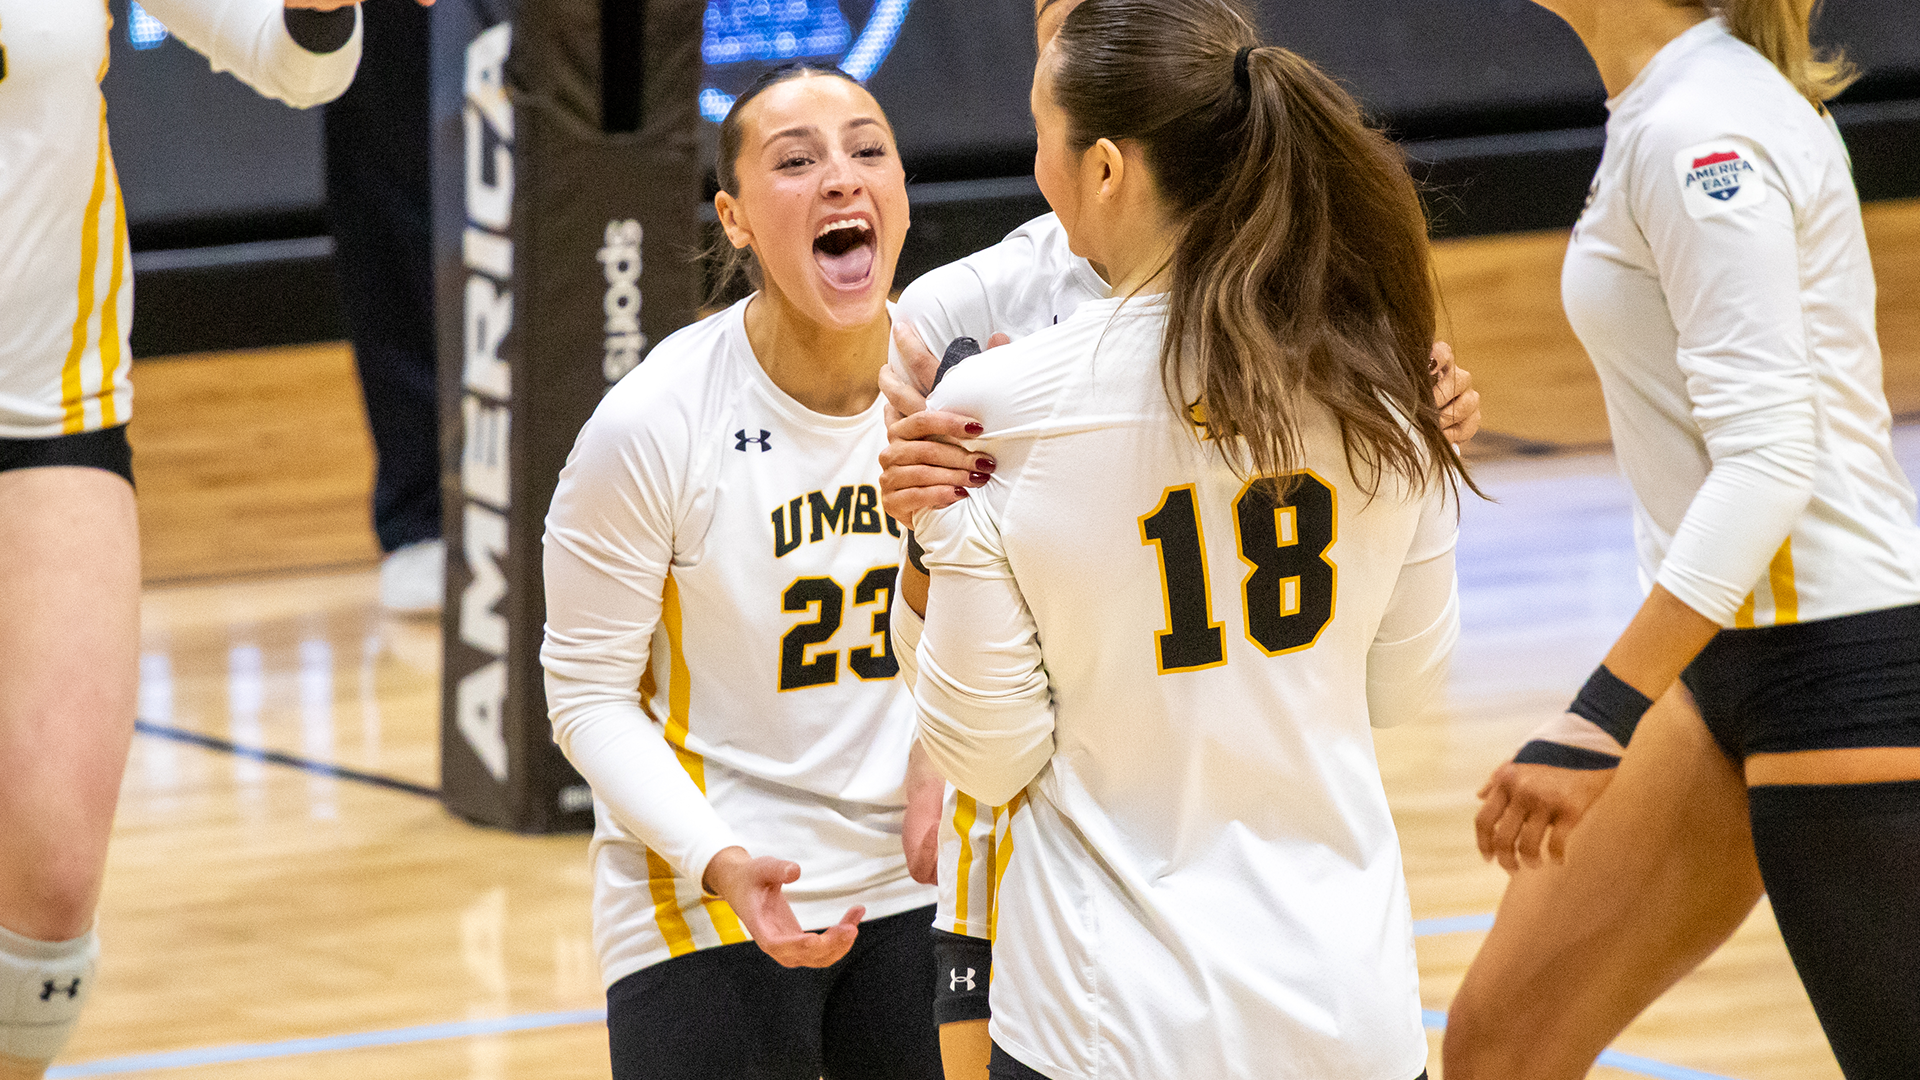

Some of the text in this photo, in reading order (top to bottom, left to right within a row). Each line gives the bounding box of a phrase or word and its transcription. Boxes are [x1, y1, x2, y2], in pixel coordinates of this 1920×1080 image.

[1685, 160, 1754, 188] AMERICA
[1702, 173, 1739, 191] EAST
[596, 218, 647, 382] sports
[457, 21, 514, 782] AMERICA
[777, 563, 900, 692] 23
[1137, 467, 1338, 676] 18
